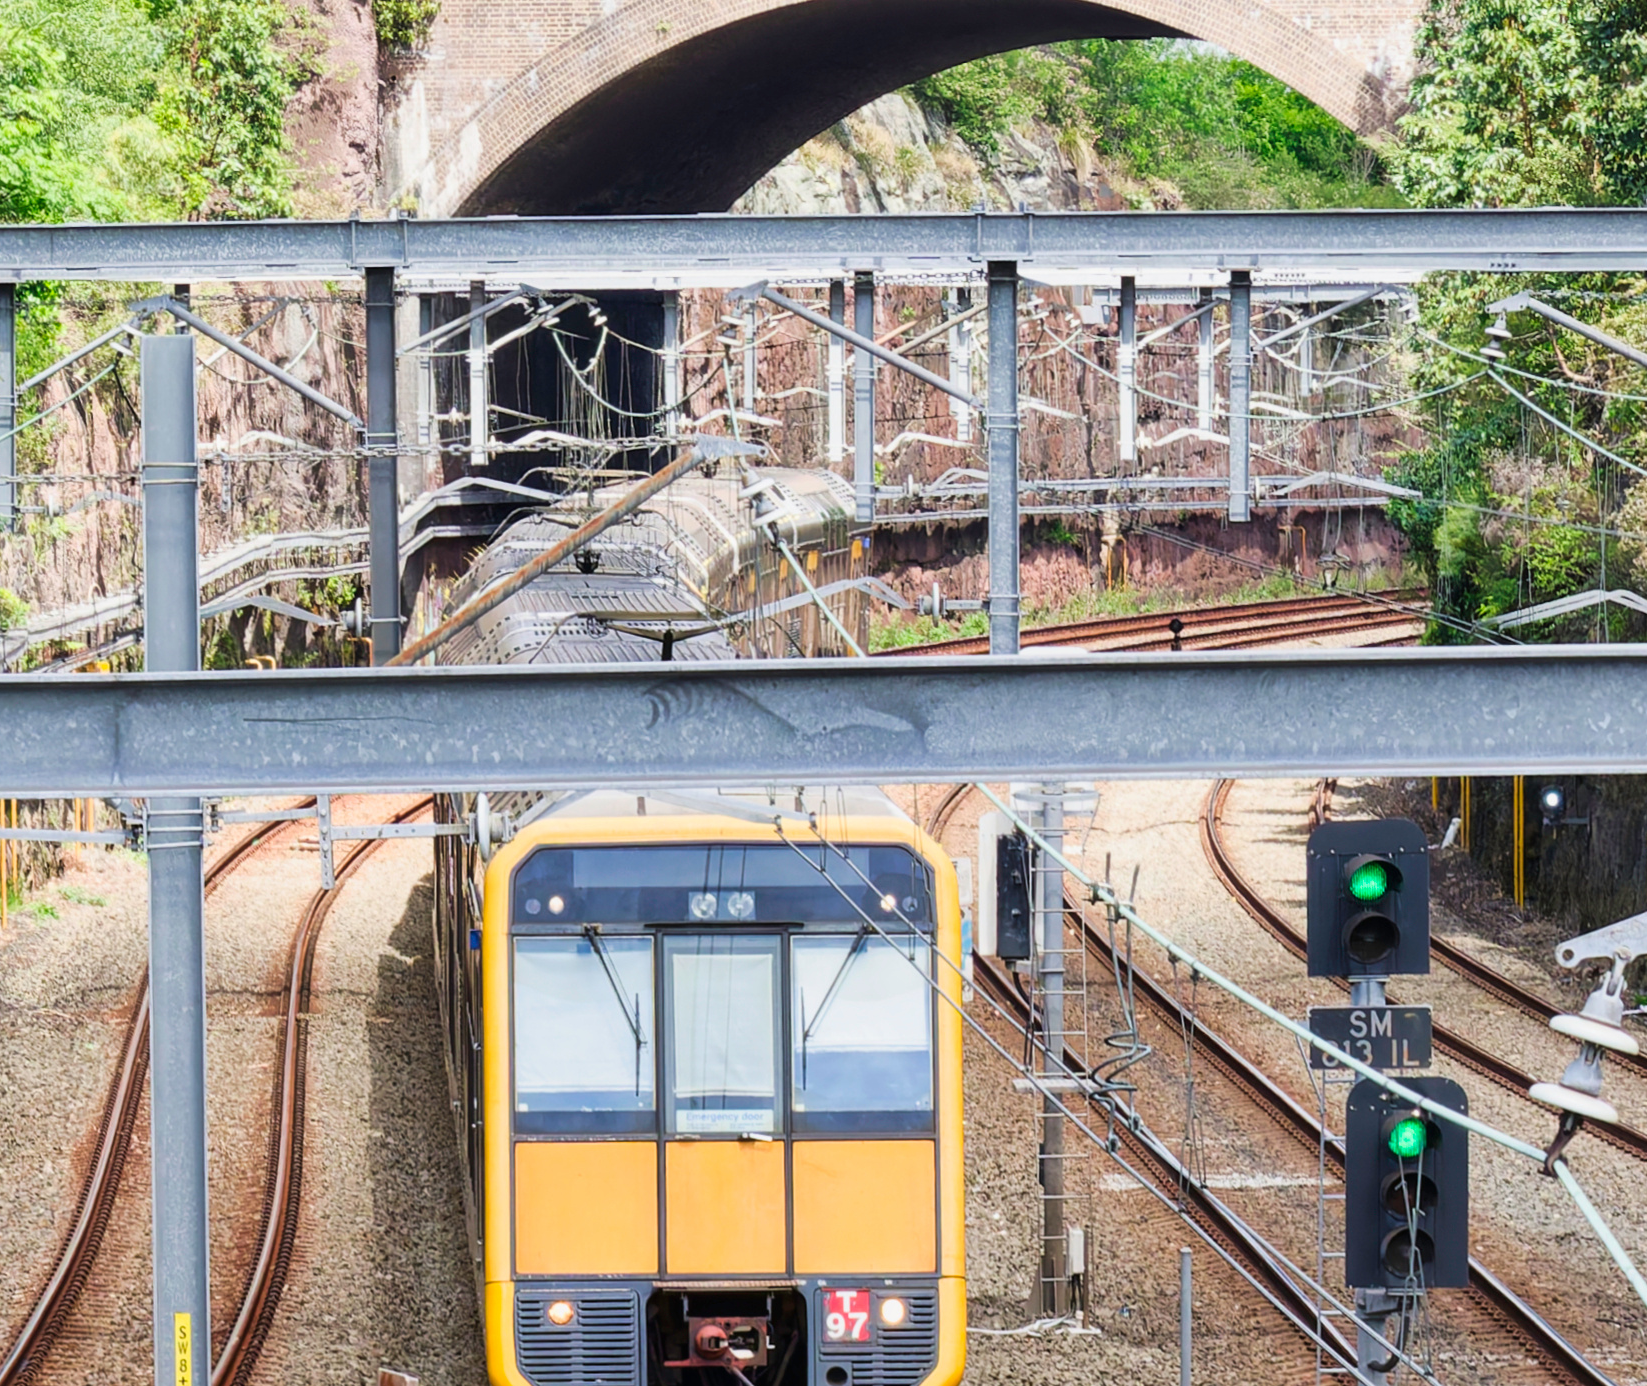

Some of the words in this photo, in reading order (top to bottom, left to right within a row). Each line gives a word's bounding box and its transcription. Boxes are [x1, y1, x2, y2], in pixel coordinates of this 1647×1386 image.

[1349, 1010, 1392, 1038] SM
[686, 1112, 739, 1122] Emergency
[742, 1112, 764, 1121] door
[835, 1290, 858, 1313] T
[826, 1312, 868, 1339] 97
